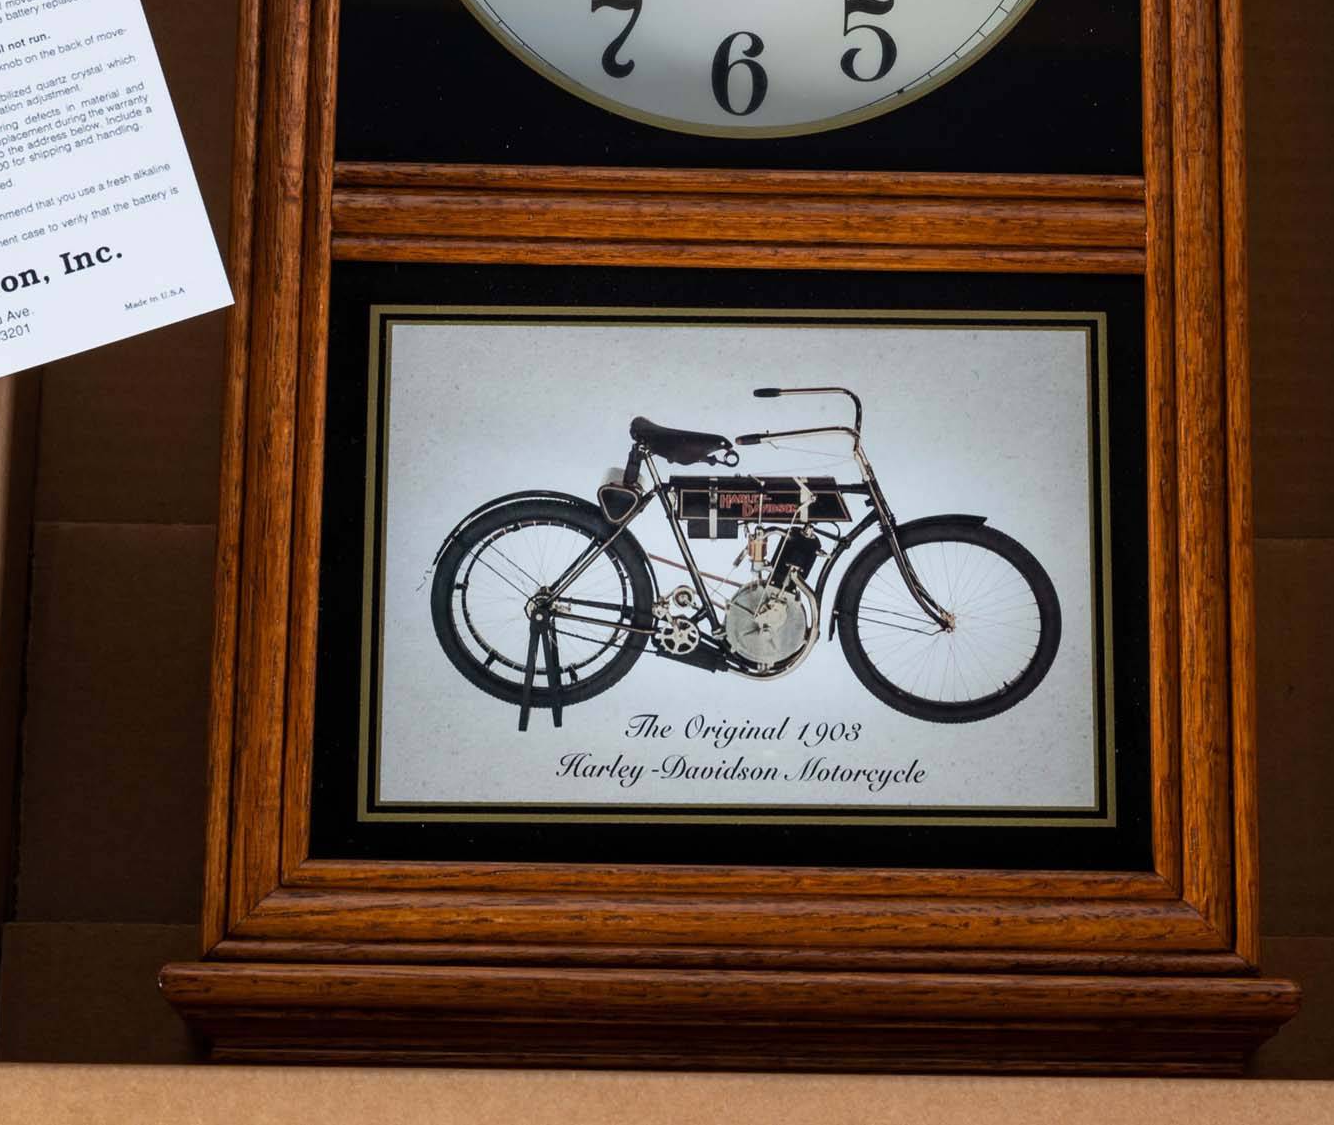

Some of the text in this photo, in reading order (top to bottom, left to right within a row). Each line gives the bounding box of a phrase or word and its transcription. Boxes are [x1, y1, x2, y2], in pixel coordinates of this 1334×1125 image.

[4, 5, 39, 20] battery
[7, 38, 26, 50] not
[28, 33, 51, 44] run.
[36, 76, 67, 91] quartz
[70, 63, 103, 80] crystal
[106, 54, 136, 68] which
[710, 31, 768, 117] 6
[24, 108, 61, 125] defects
[81, 89, 119, 108] material
[125, 81, 144, 94] and
[54, 113, 86, 128] during
[87, 108, 104, 118] the
[105, 94, 147, 112] warranty
[12, 157, 25, 166] for
[29, 143, 72, 162] shipping
[74, 134, 94, 148] and
[58, 246, 122, 275] Inc.
[625, 714, 863, 749] The Original 1903
[783, 757, 927, 793] Motorcycle
